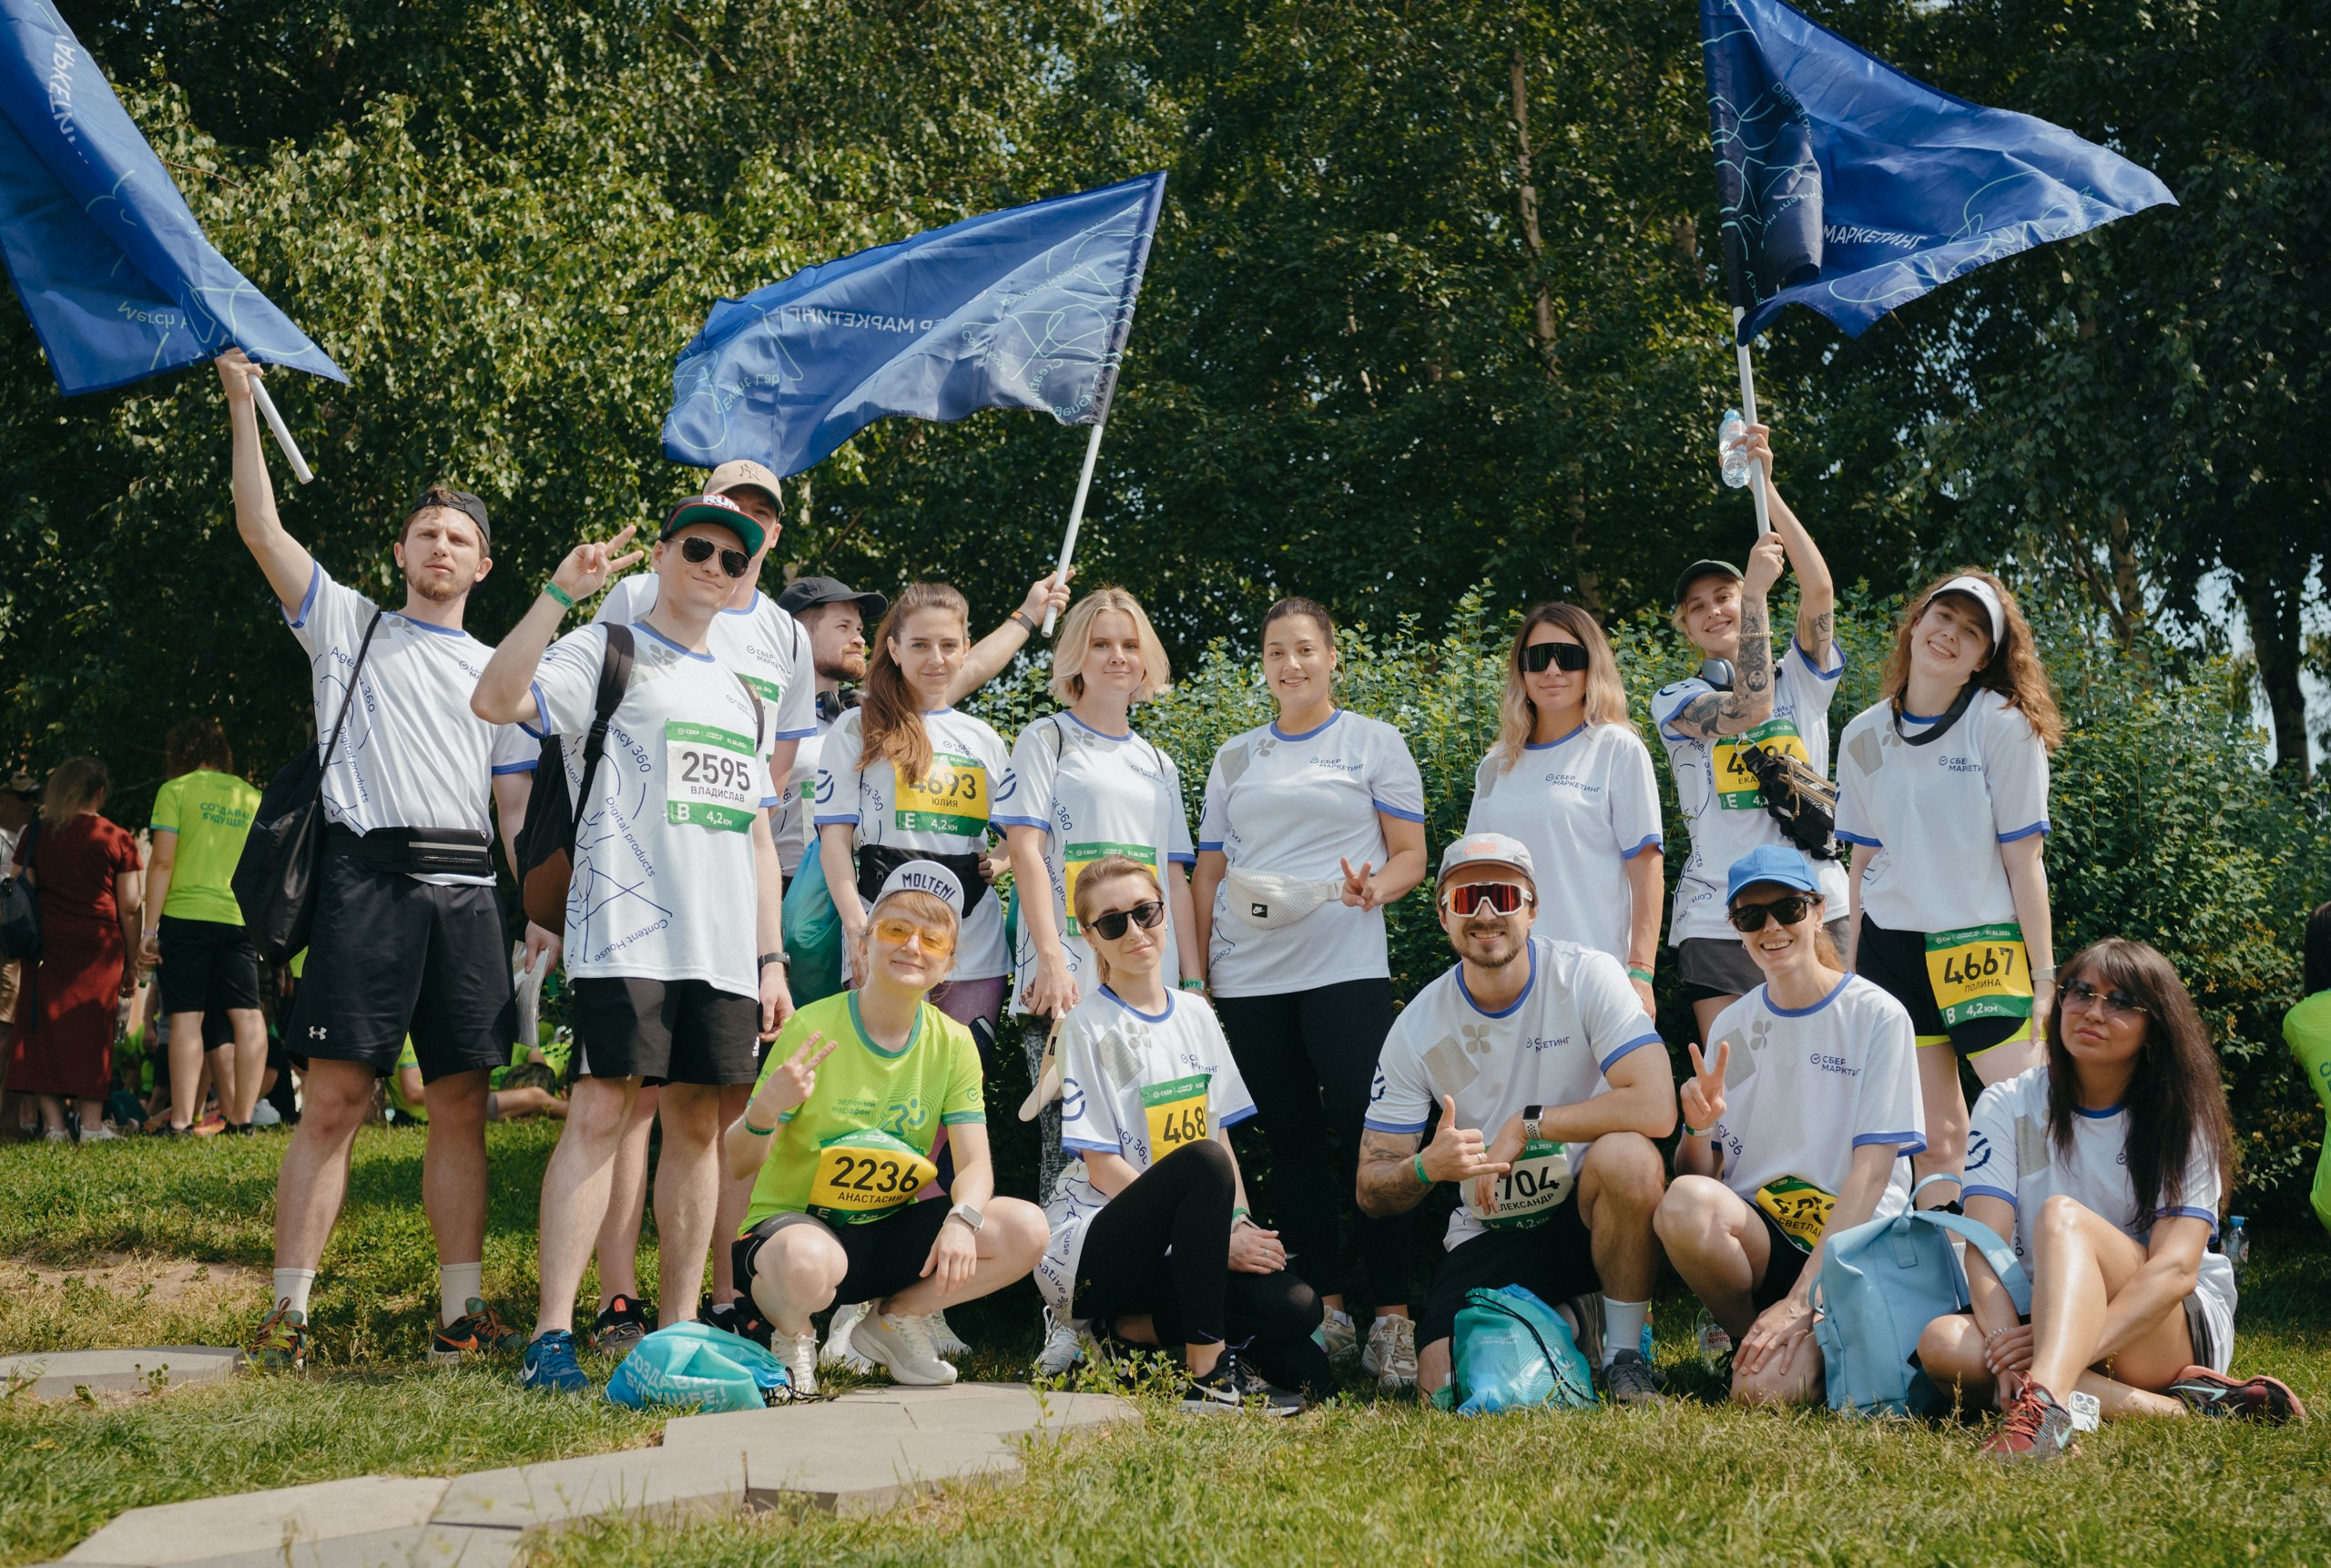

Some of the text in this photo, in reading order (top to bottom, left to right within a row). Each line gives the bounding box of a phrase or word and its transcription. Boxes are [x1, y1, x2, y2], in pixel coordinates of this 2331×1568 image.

[1777, 192, 1824, 212] ontent
[1822, 224, 1928, 249] МАРКЕТИНГ
[364, 686, 375, 713] 360
[606, 722, 652, 773] ency 360
[560, 738, 583, 789] erch Hous
[682, 751, 750, 791] 2595
[1319, 763, 1364, 771] МАРКЕТИНГ
[349, 759, 369, 803] products
[1553, 780, 1601, 793] МАРКЕТИНГ
[691, 786, 745, 802] ВЛАДИСЛАВ
[872, 789, 883, 811] 360
[931, 798, 958, 808] ЮЛИЯ
[1057, 806, 1073, 831] 360
[606, 796, 655, 878] Digital products
[1043, 856, 1060, 885] Digital
[902, 873, 956, 901] MOLTENI
[595, 919, 668, 962] Content House
[1944, 947, 2014, 984] 4667
[1965, 979, 2001, 993] ПОЛИНА
[831, 1105, 870, 1115] марафон
[1164, 1105, 1206, 1144] 468
[1526, 1143, 1552, 1152] 1.06.2024
[830, 1156, 920, 1193] 2236
[838, 1192, 903, 1204] АНАСТАСИЯ
[1500, 1193, 1554, 1211] ЛЕКСАНДР
